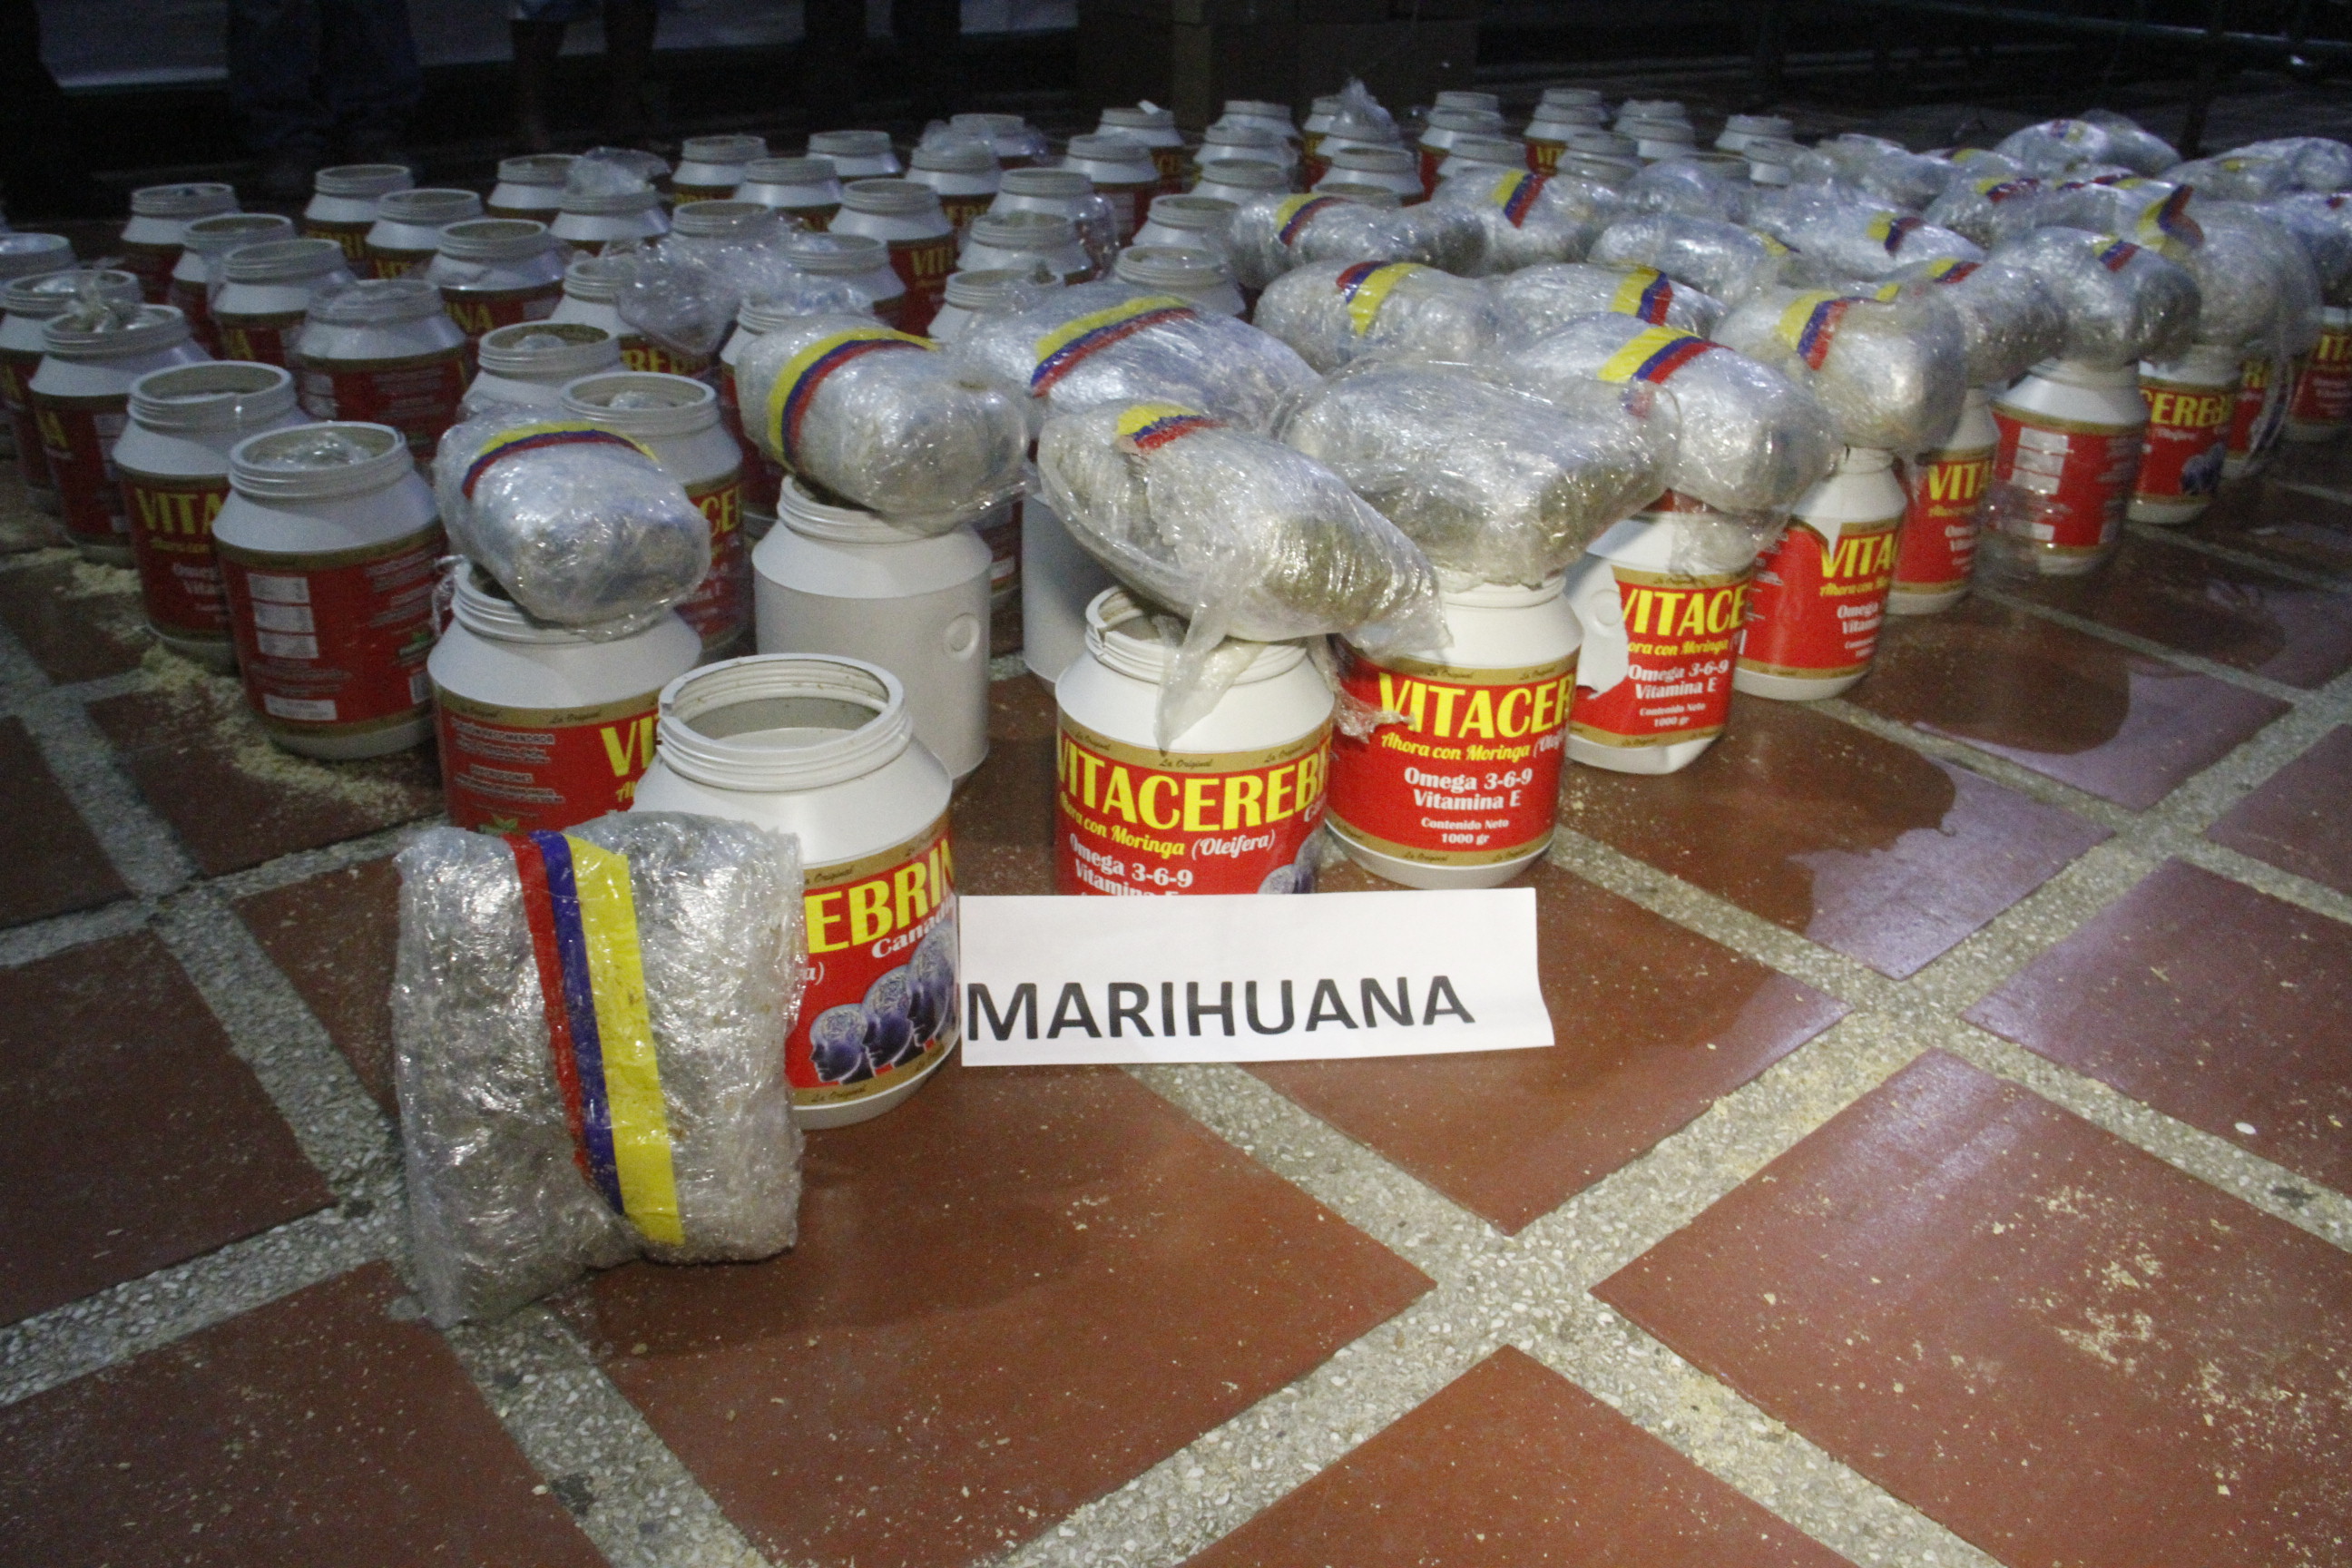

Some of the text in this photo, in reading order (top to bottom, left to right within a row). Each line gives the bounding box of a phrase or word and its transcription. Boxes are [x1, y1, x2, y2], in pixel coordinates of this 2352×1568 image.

[1628, 659, 1730, 683] Omega 3-6-9
[1634, 677, 1718, 700] Vitamina E
[599, 713, 660, 778] VI
[1381, 731, 1429, 757] Ahora
[1432, 746, 1461, 760] con
[1466, 744, 1531, 763] Moringa
[1404, 767, 1534, 794] Omega 3-6-9
[1413, 789, 1523, 811] Vitamina E
[1420, 817, 1510, 831] Contenido Neto
[1083, 818, 1108, 838] con
[1112, 825, 1185, 859] Moringa
[1191, 829, 1277, 861] (Oleifera)
[1441, 832, 1491, 846] 1000 gr
[1069, 833, 1194, 888] Omega 3-6-9
[966, 975, 1476, 1042] MARIHUANA
